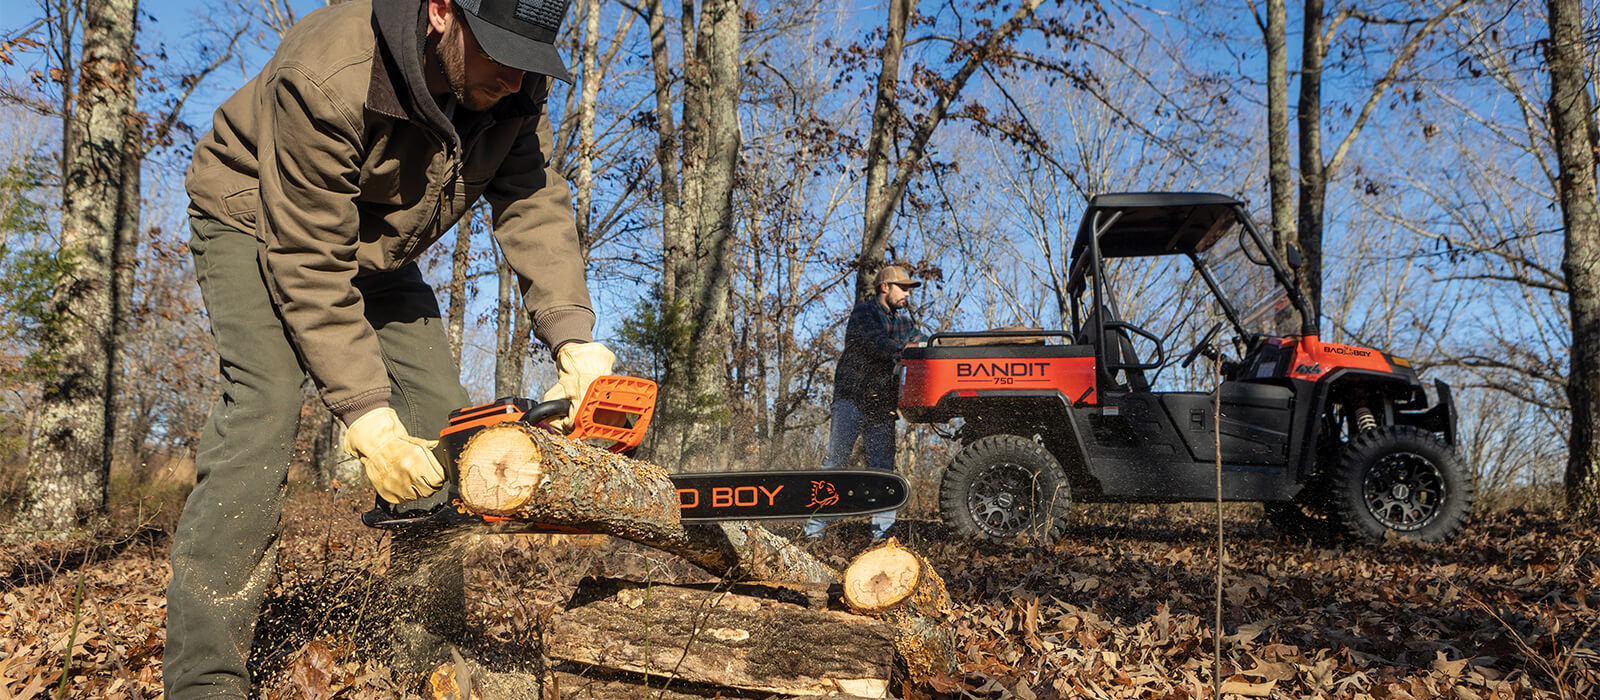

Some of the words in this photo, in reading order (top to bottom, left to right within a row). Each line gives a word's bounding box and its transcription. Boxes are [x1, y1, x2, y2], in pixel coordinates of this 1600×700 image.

[1323, 346, 1344, 355] BAD
[1353, 349, 1371, 357] BOY
[957, 362, 1050, 377] BANDIT
[1295, 363, 1321, 375] 4x4
[994, 377, 1014, 385] 750
[712, 484, 785, 508] BOY
